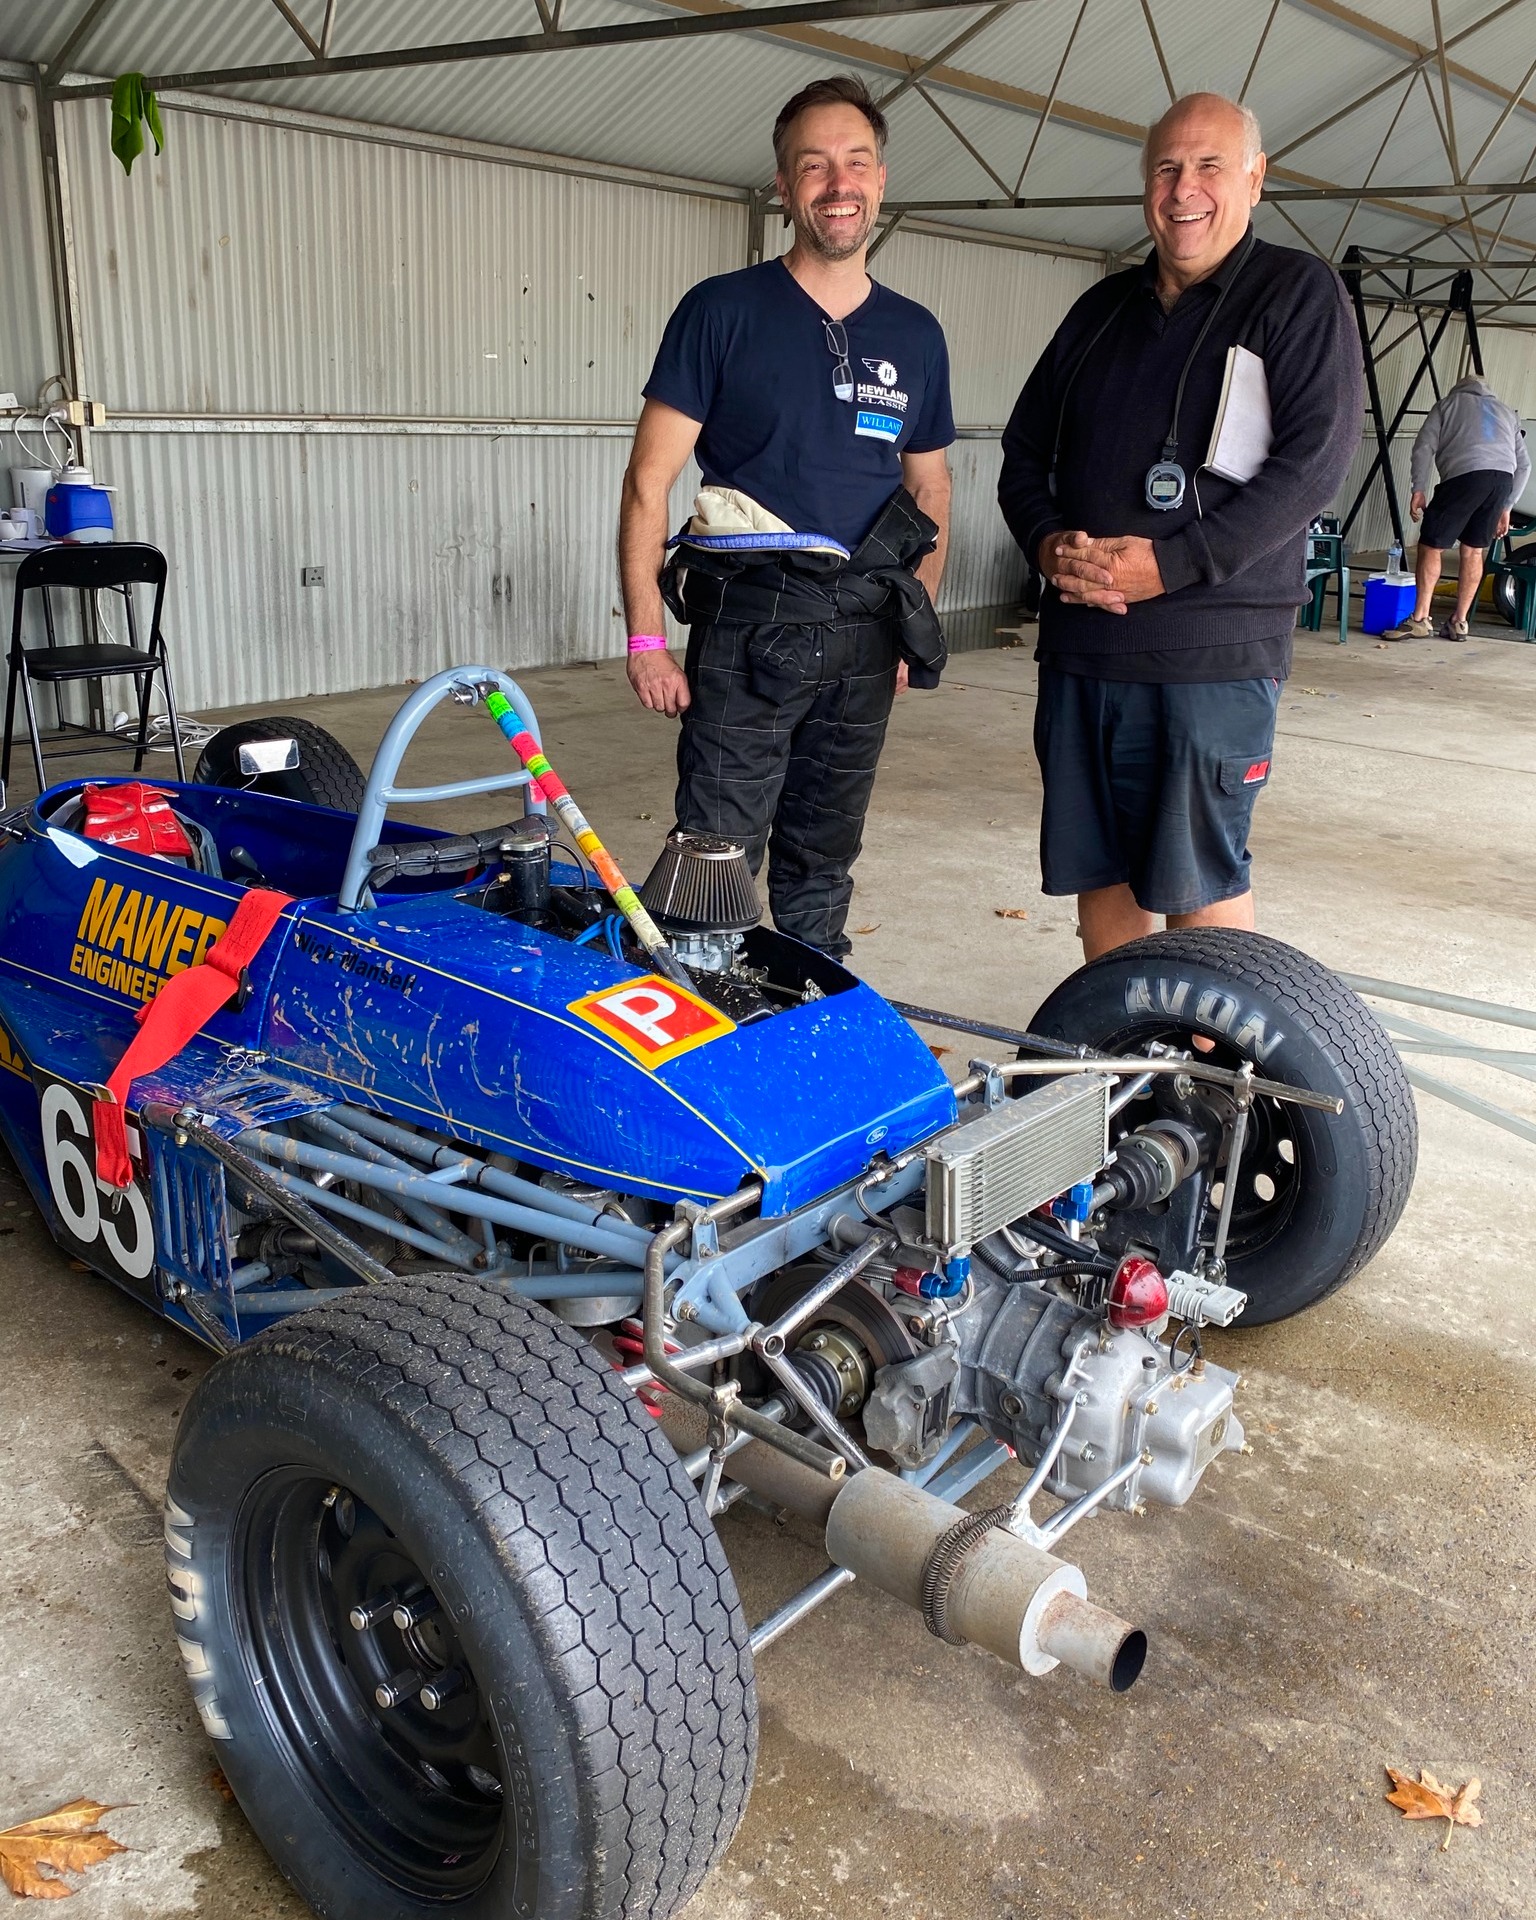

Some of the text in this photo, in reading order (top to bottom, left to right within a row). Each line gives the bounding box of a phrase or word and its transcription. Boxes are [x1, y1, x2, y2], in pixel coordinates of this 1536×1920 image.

[857, 383, 909, 404] HEWLAND
[857, 396, 908, 413] CLASSIC
[298, 932, 418, 997] Nick Mansell
[595, 986, 677, 1046] P
[1124, 976, 1285, 1066] AVON
